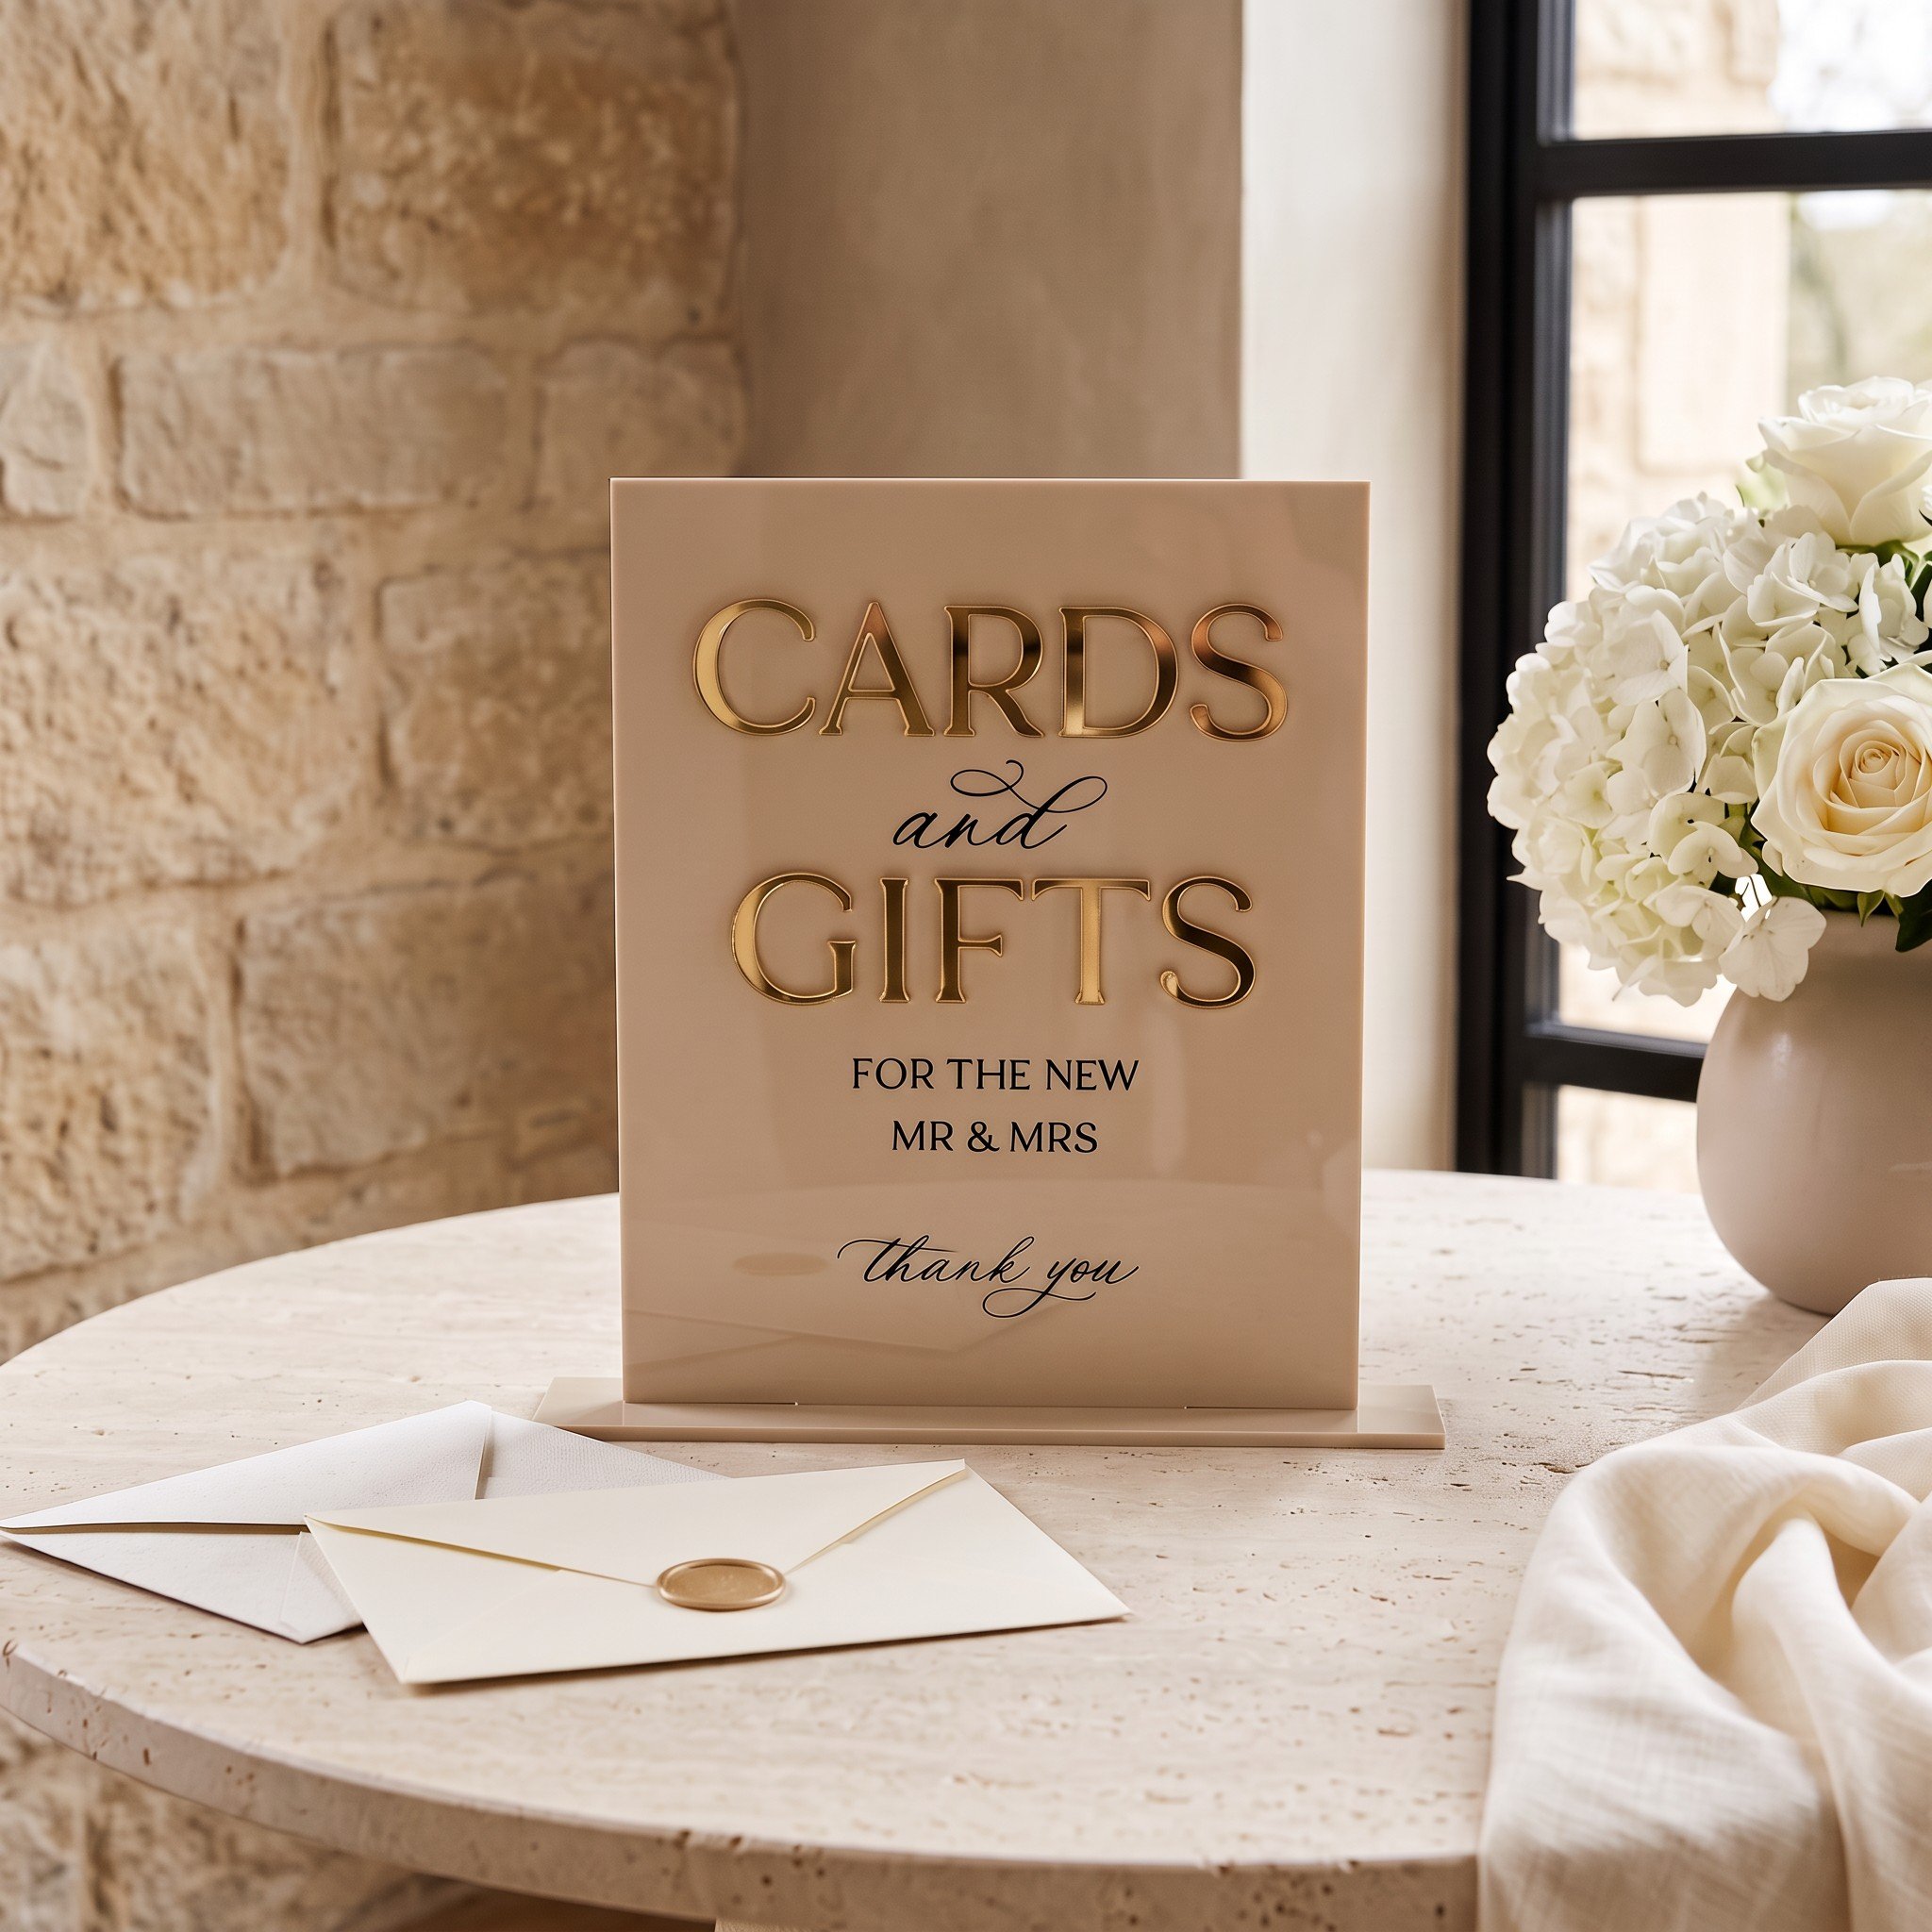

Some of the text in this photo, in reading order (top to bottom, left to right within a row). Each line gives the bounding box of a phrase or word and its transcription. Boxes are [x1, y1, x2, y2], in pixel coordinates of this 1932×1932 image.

[692, 598, 1288, 741] CARDS
[892, 758, 1108, 850] and
[731, 873, 1257, 1008] GIFTS
[852, 1058, 1140, 1091] FOR THE NEW
[891, 1120, 1098, 1154] MR & MRS
[837, 1234, 1140, 1319] thank you
